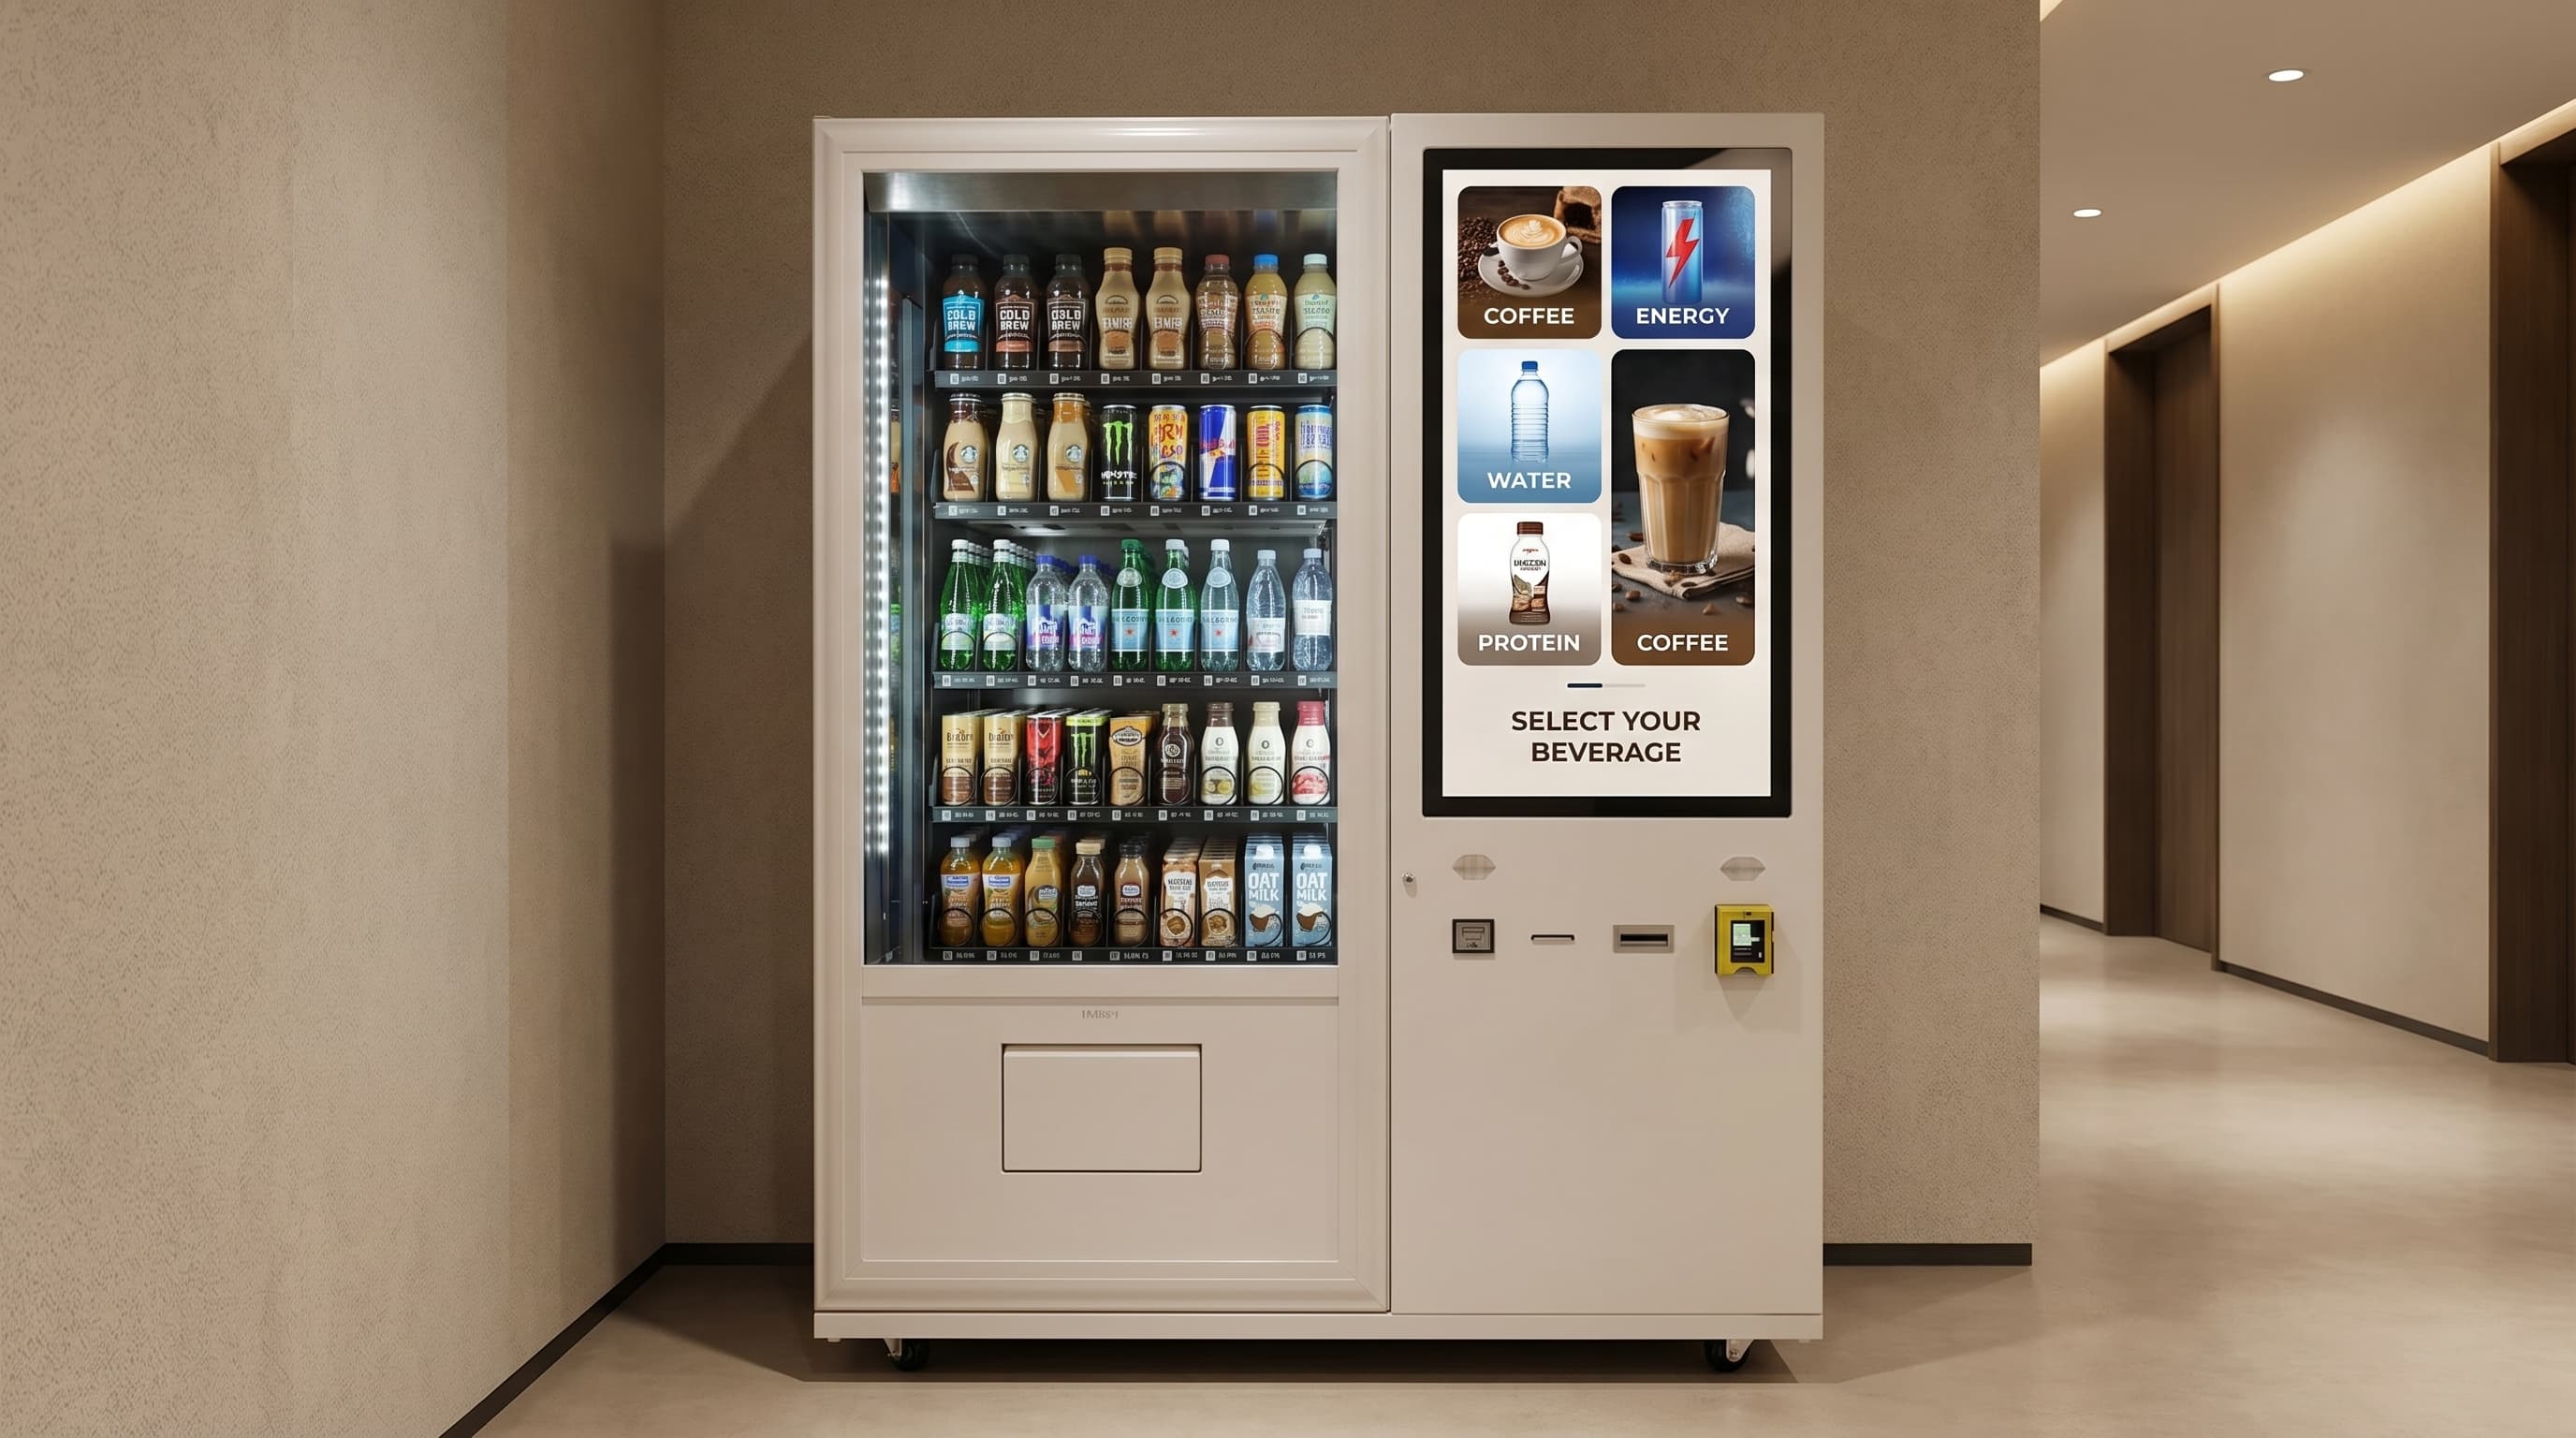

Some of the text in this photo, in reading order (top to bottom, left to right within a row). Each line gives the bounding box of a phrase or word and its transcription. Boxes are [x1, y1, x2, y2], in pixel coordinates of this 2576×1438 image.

[1000, 310, 1030, 320] COLD
[1484, 307, 1574, 325] COFFEE
[1635, 307, 1730, 325] ENERGY
[947, 321, 976, 330] BREW
[1000, 321, 1029, 330] BREW
[1487, 472, 1572, 489] WATER
[1479, 634, 1580, 652] PROTEIN
[1637, 634, 1729, 652] COFFEE
[1512, 711, 1701, 731] SELECT YOUR
[1531, 741, 1682, 763] BEVERAGE
[1248, 872, 1280, 889] OAT
[1295, 872, 1328, 889] OAT
[1249, 889, 1280, 902] MILK
[1296, 888, 1327, 902] MILK
